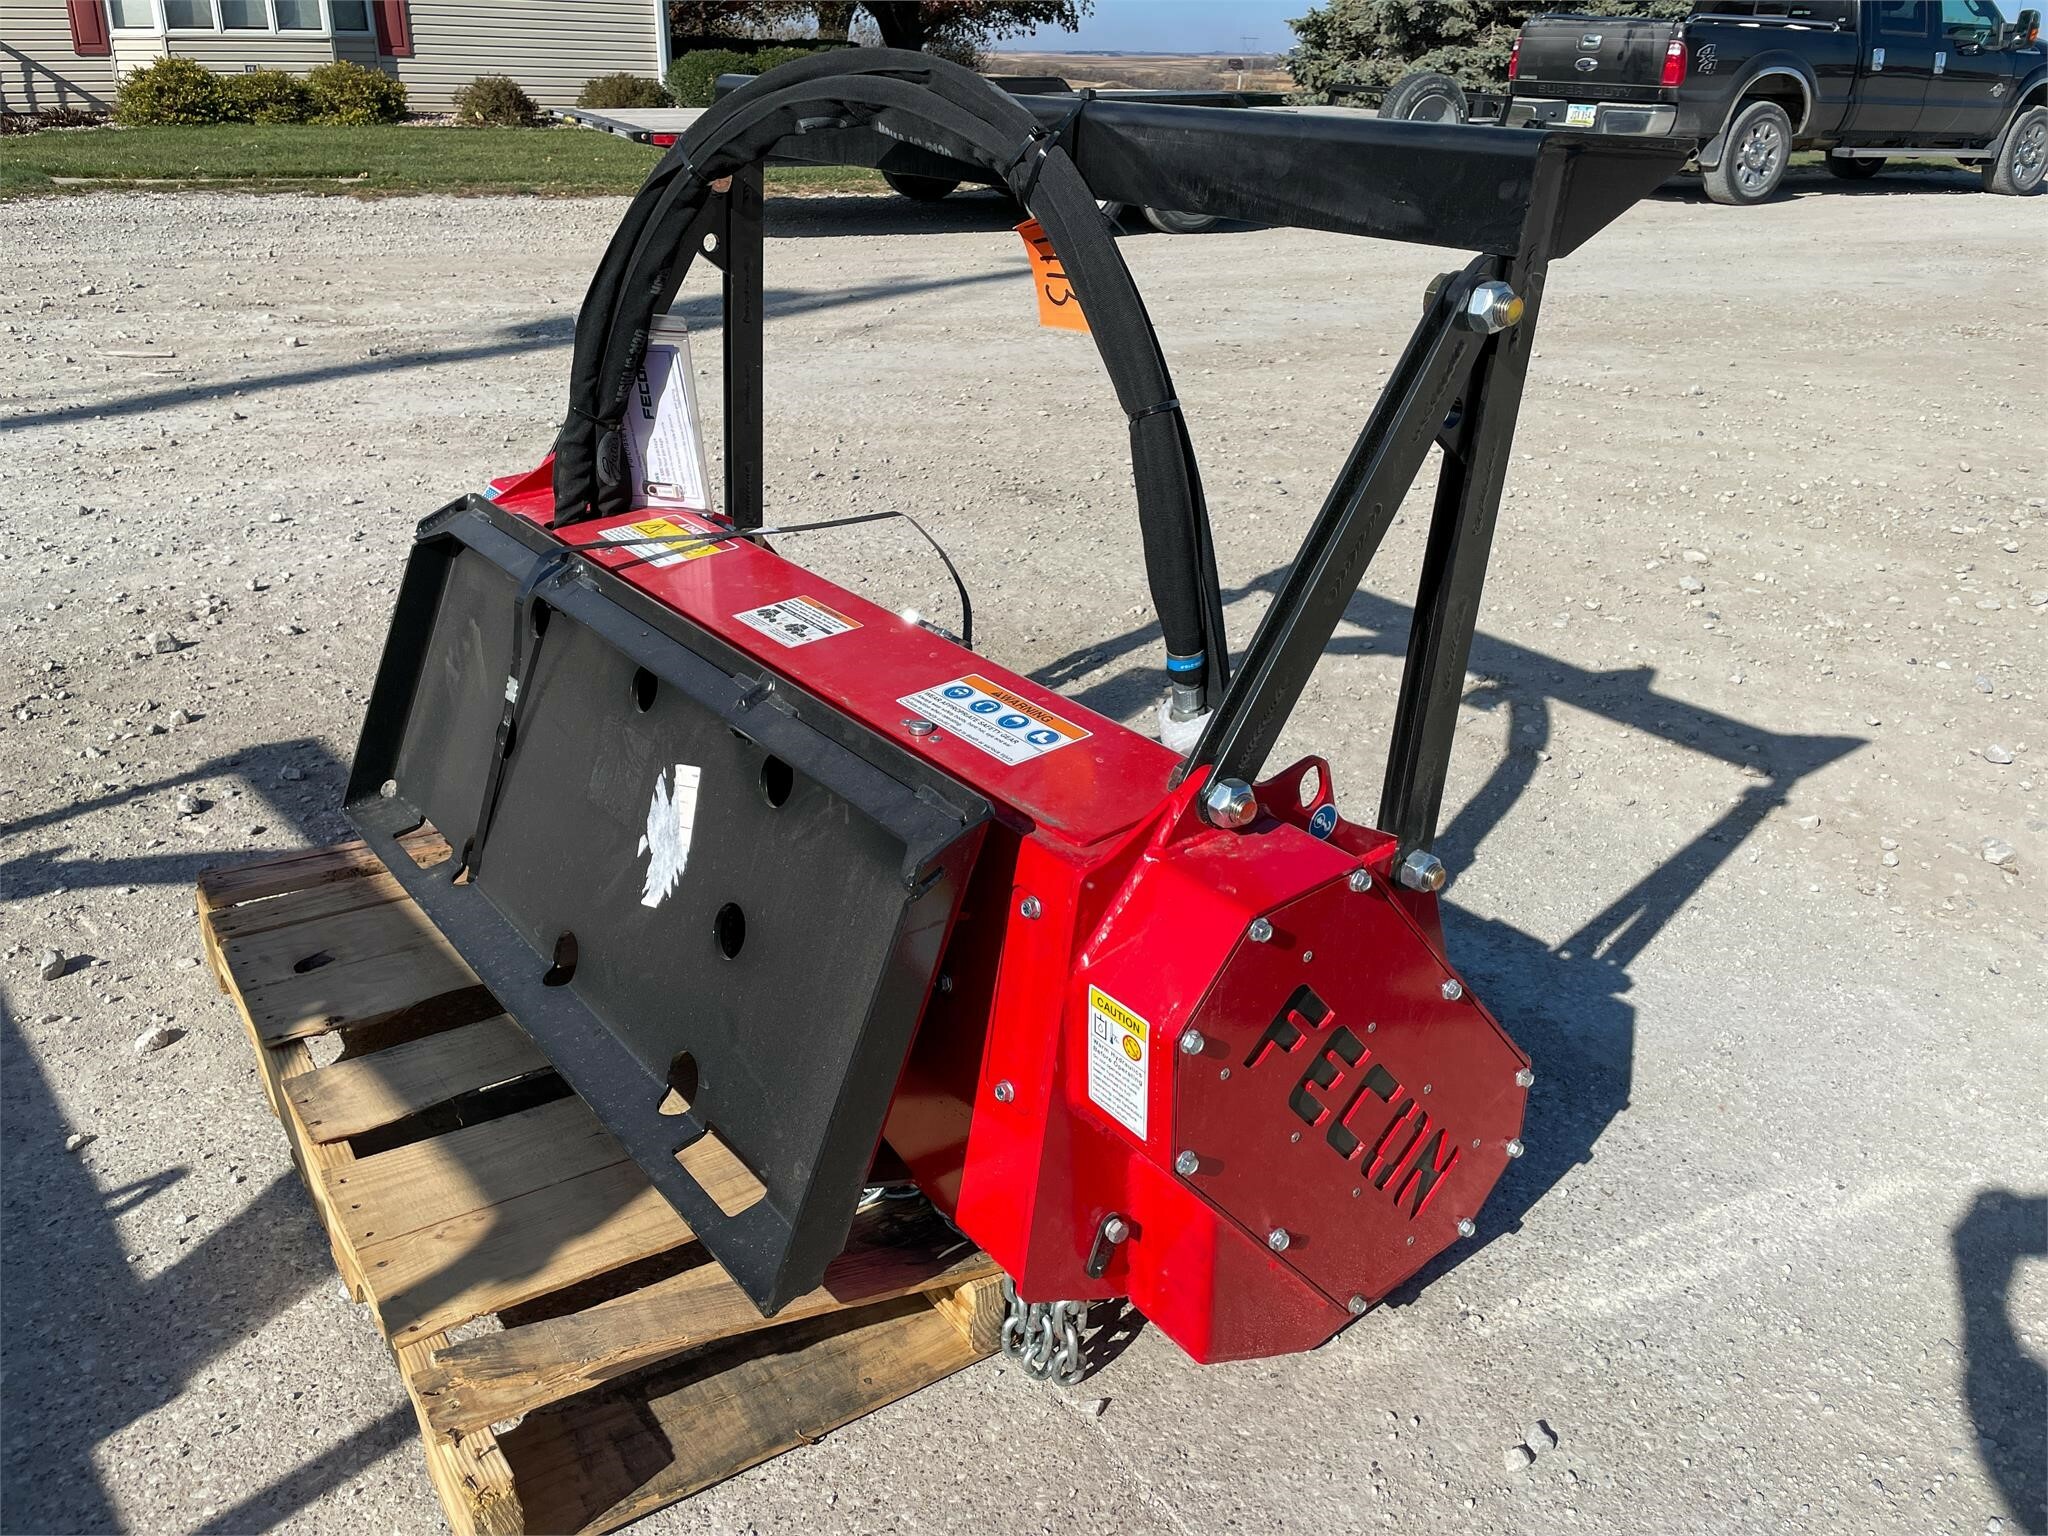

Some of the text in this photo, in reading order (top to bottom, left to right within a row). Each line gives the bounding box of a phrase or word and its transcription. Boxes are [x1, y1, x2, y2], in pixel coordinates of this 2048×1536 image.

[1537, 83, 1633, 97] SUPER DUTY
[638, 366, 655, 420] FECO
[924, 692, 1019, 744] WEAR APPROPRIATE SAFETY GEAR
[1000, 693, 1054, 723] WARNING
[1097, 996, 1140, 1034] CAUTION
[1093, 1038, 1142, 1079] Warm Hydraulics
[1093, 1044, 1142, 1087] Before Operating
[1243, 983, 1461, 1222] FECON
